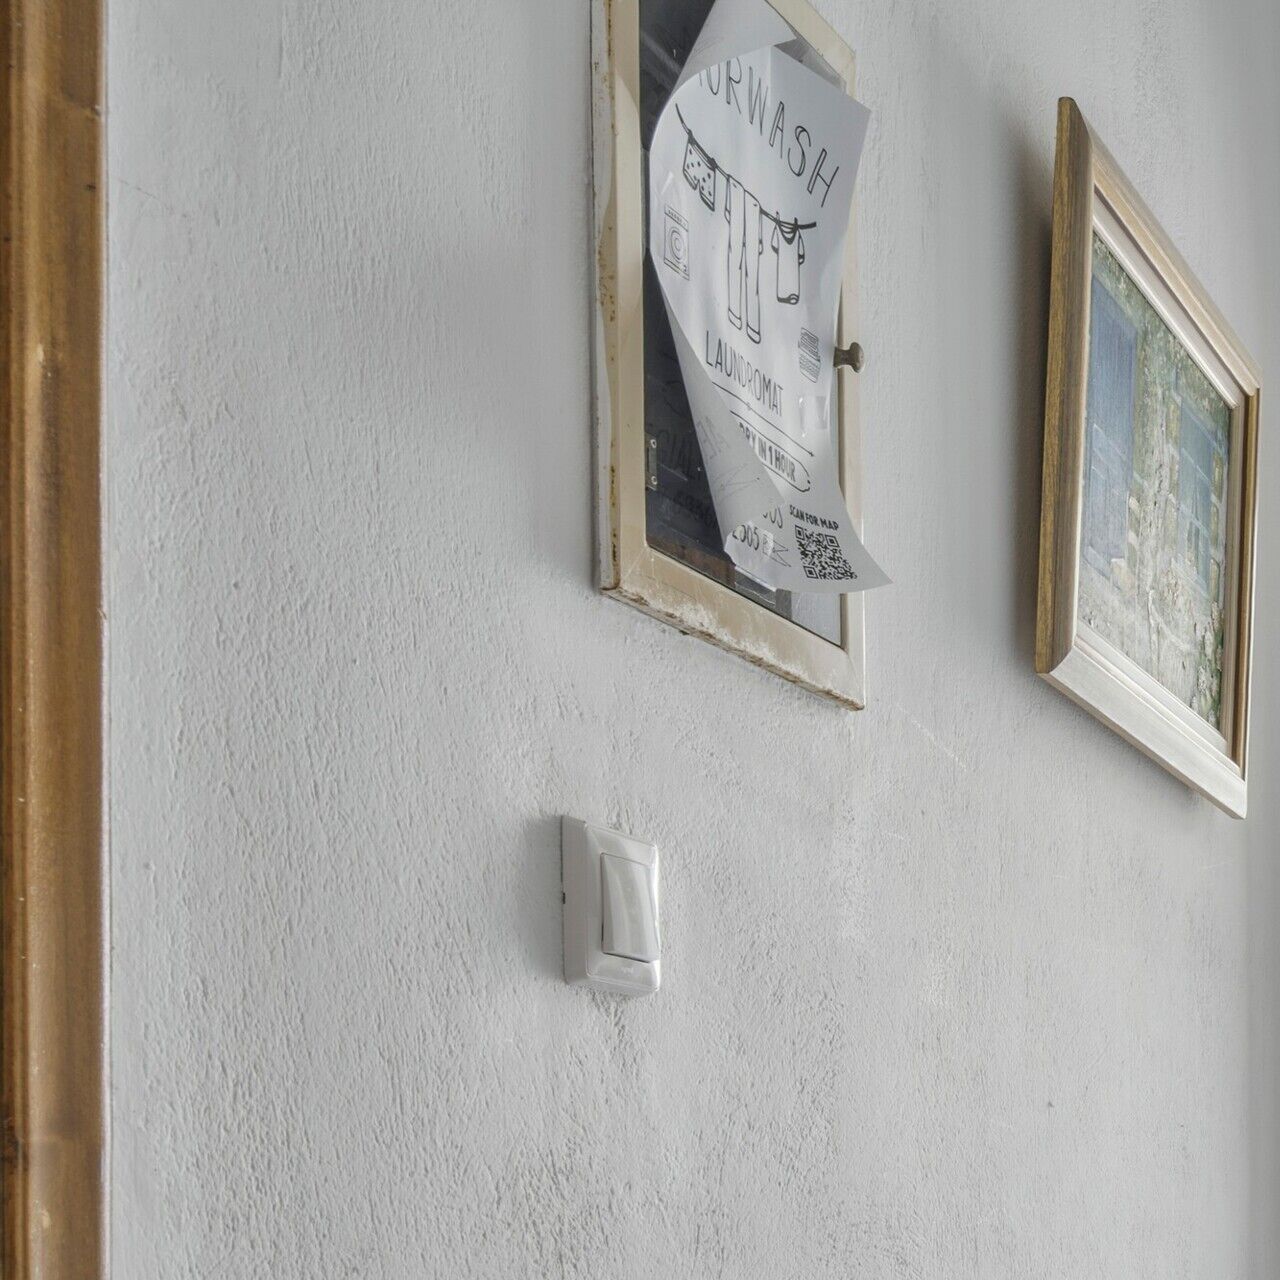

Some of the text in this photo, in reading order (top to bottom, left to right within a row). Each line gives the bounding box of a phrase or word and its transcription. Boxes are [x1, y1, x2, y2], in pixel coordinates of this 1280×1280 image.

[705, 330, 784, 417] LAUNDROMAT
[757, 436, 767, 462] IN
[768, 446, 773, 466] 1
[774, 448, 796, 482] HOUR
[789, 503, 839, 531] SCAN FOR MAP
